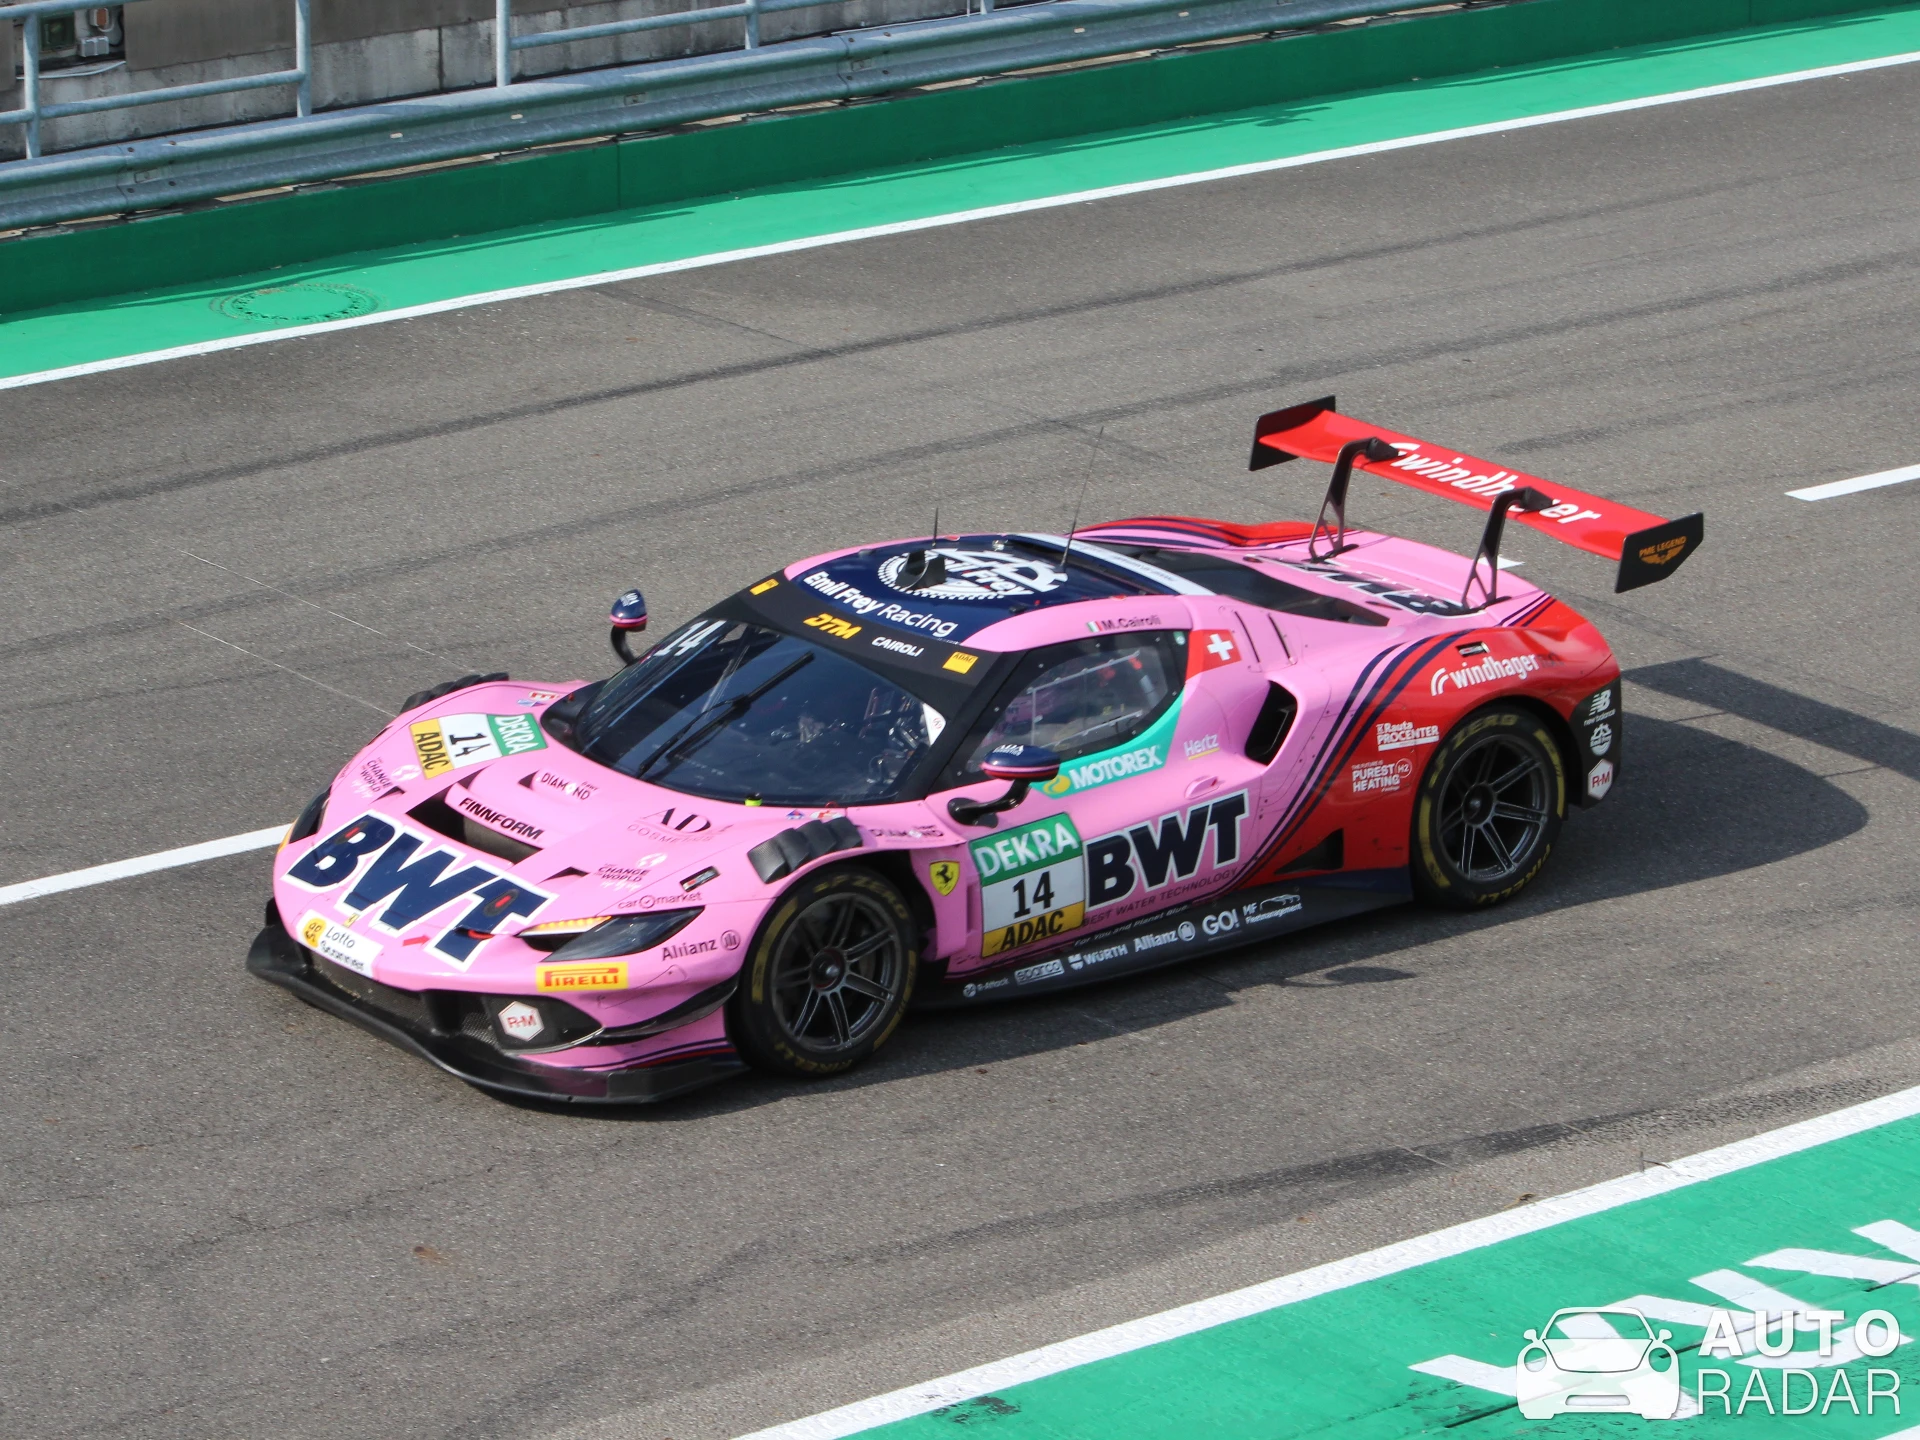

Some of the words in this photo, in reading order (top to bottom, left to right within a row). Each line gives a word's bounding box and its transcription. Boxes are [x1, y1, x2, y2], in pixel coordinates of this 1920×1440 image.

[1390, 453, 1602, 524] windher
[1639, 545, 1656, 559] PME
[1656, 536, 1687, 553] LEGEND
[803, 571, 850, 600] Emil
[843, 587, 885, 615] Frey
[877, 604, 959, 638] Racing
[653, 619, 727, 657] 14
[803, 613, 863, 640] DTM
[871, 636, 924, 657] CAIROLI
[953, 652, 974, 663] ADAC
[1449, 653, 1540, 689] windhager
[495, 714, 540, 755] DEKRA
[1377, 725, 1439, 745] PROCENTER
[1384, 720, 1414, 733] Rauta
[414, 731, 450, 771] ADAC
[448, 731, 491, 758] 14
[1184, 734, 1220, 757] Hertz
[366, 760, 393, 788] CHANGE
[1069, 745, 1163, 789] MOTOREX
[1352, 763, 1395, 781] PUREST
[1353, 774, 1400, 792] HEATING
[459, 797, 544, 840] FINNFORM
[974, 822, 1080, 879] DEKRA
[1084, 790, 1250, 911] BWT
[282, 810, 559, 971] BWT
[1012, 870, 1055, 919] 14
[1084, 912, 1112, 927] BEST
[1115, 899, 1156, 916] WATER
[1160, 867, 1238, 902] TECHNOLOGY
[1001, 910, 1065, 951] ADAC
[1202, 908, 1240, 935] GO!
[325, 926, 356, 949] Lotto
[661, 938, 718, 962] Allianz
[1134, 929, 1178, 952] Allianz
[1083, 943, 1128, 966] WÜRTH
[544, 967, 620, 988] PIRELLI
